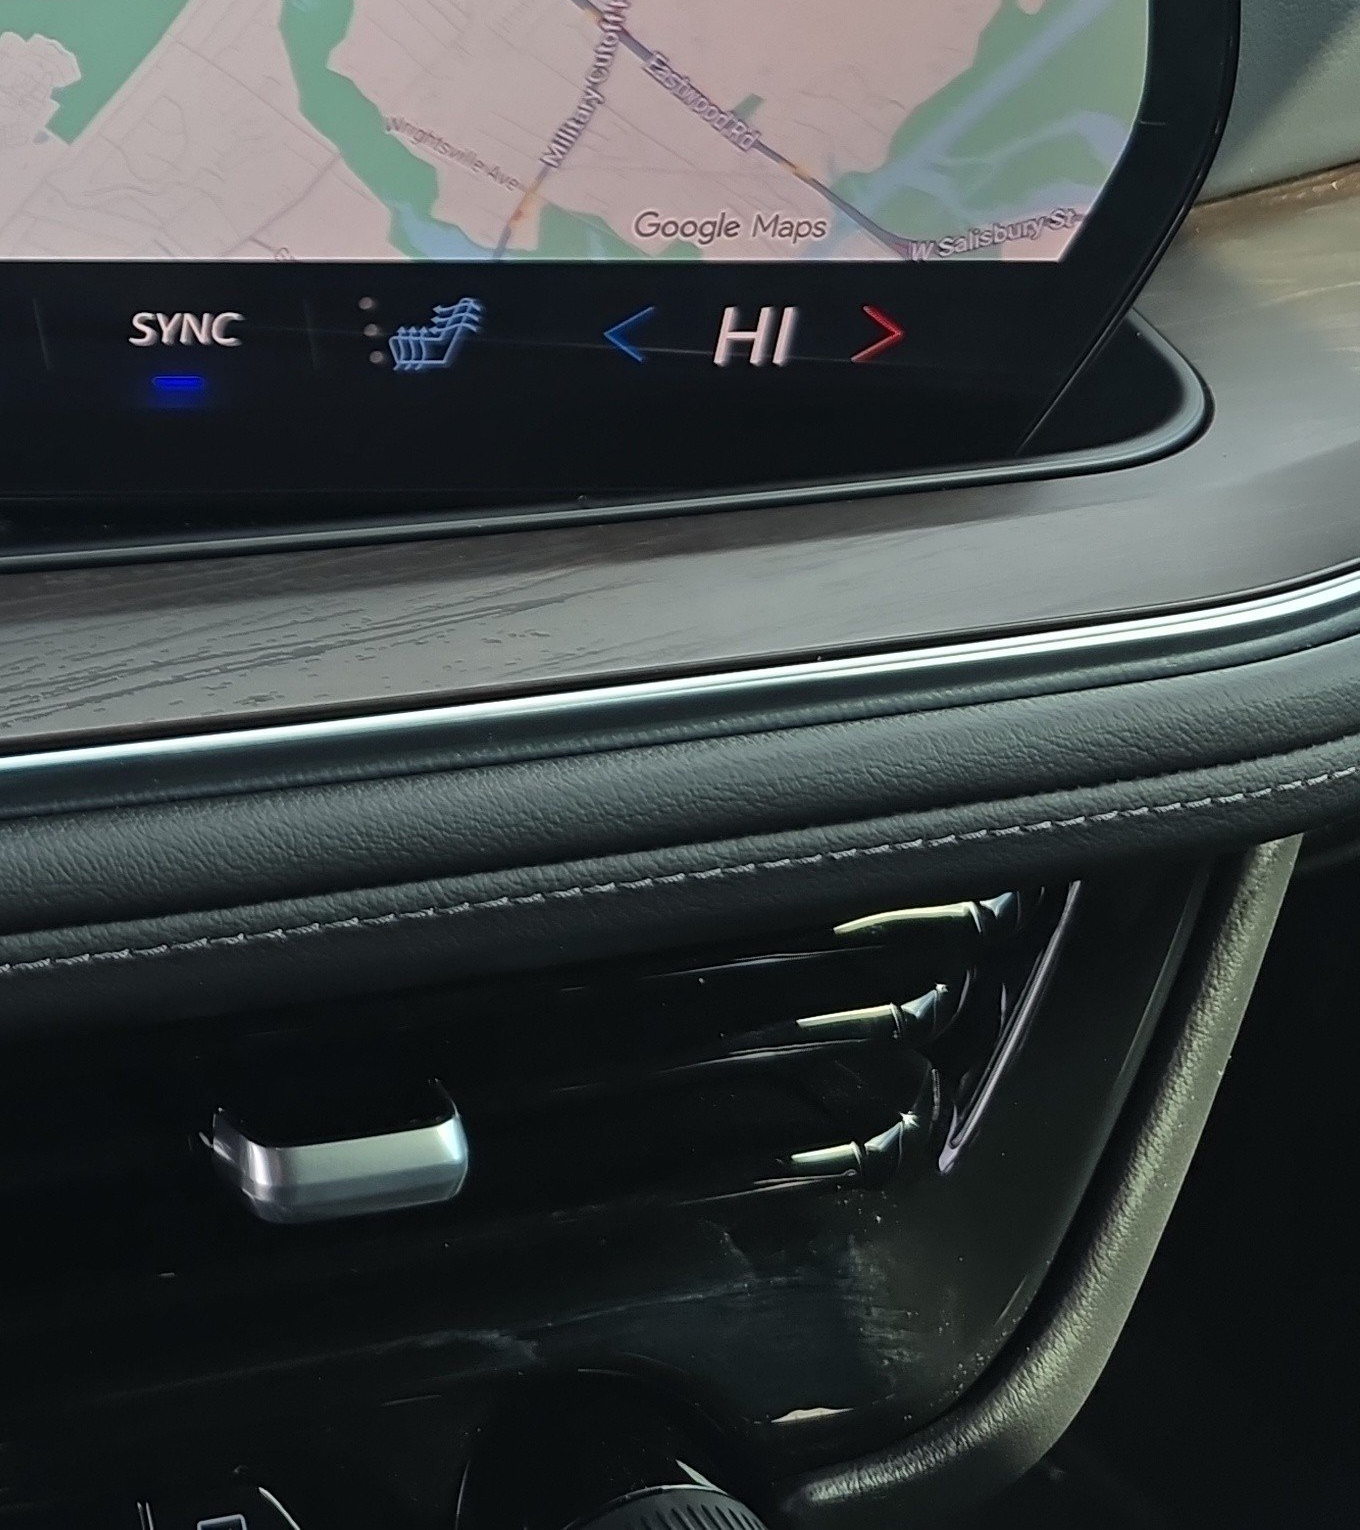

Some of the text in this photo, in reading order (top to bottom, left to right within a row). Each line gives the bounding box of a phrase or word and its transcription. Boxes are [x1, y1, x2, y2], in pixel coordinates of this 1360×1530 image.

[540, 85, 605, 168] Military
[646, 51, 762, 152] Eastwood Rd
[634, 211, 827, 245] Google Maps
[911, 208, 1077, 261] W Salisbury St
[129, 311, 245, 347] SYNC
[713, 306, 797, 367] HI
